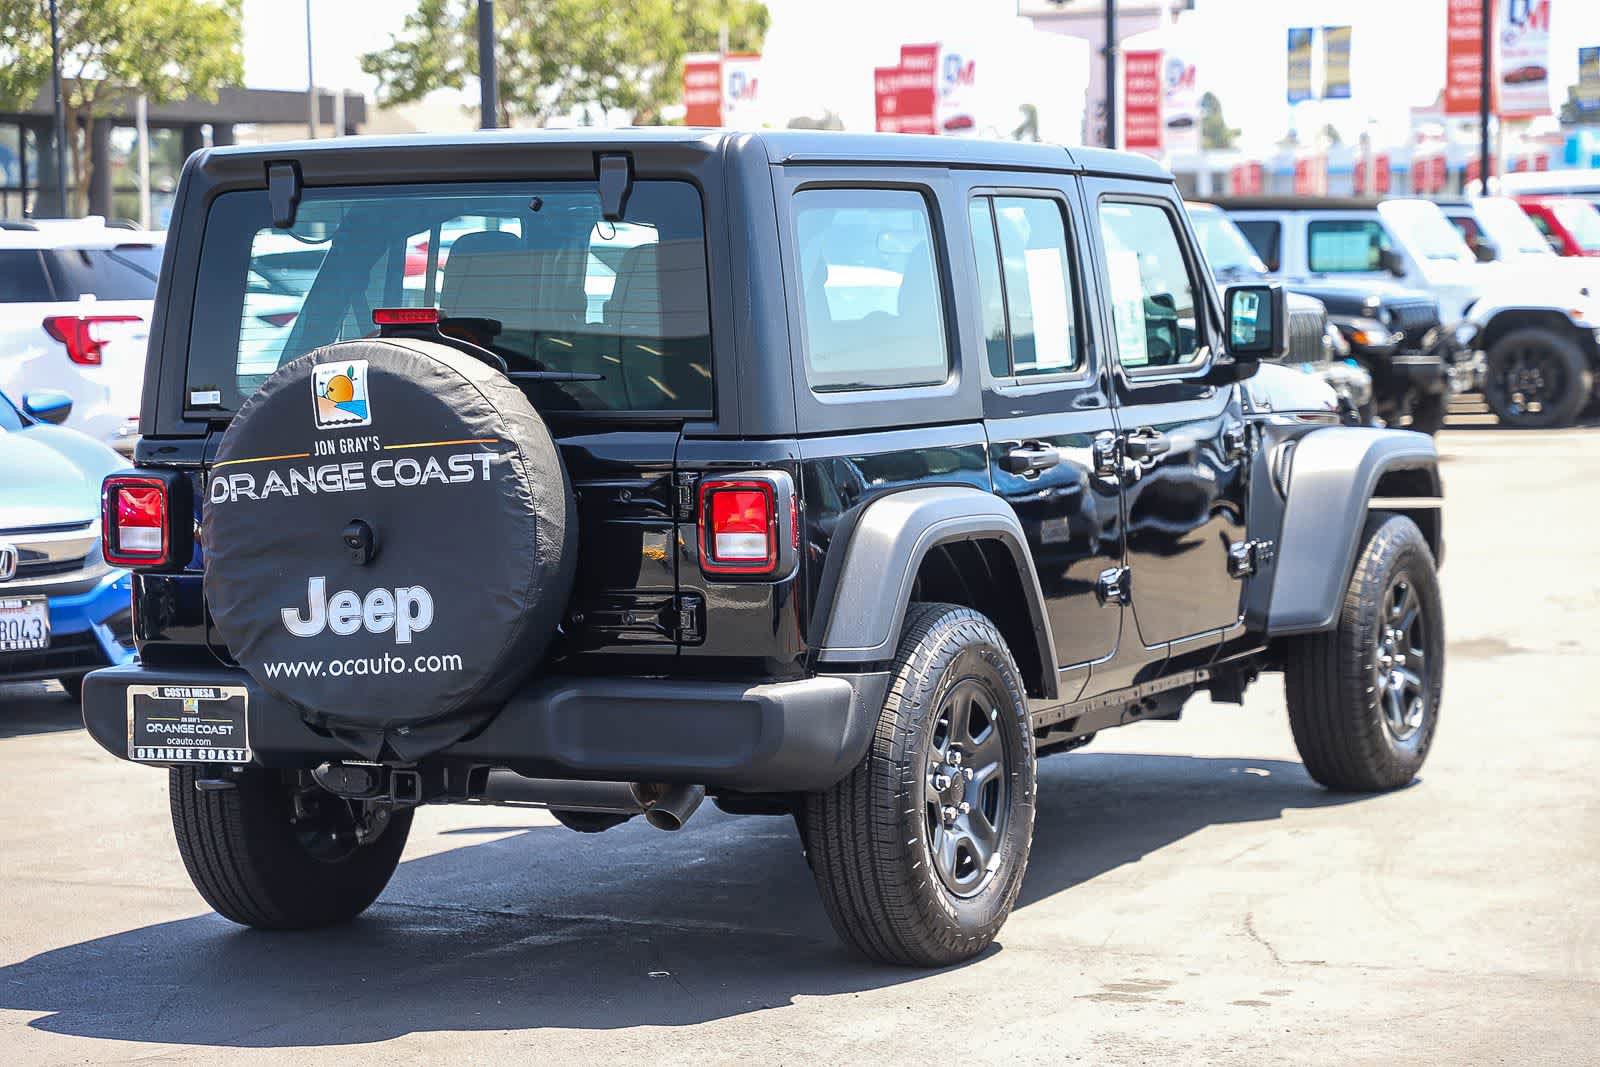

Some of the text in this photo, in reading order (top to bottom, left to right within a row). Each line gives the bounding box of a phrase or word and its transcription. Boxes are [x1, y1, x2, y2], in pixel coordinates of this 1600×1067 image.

[314, 436, 381, 457] JON GRAY'S
[210, 453, 500, 505] ORANGE COAST
[280, 576, 434, 645] Jeep
[264, 652, 463, 679] www.ocauto.com
[163, 687, 215, 698] COSTA MESA
[145, 723, 234, 736] ORANGE COAST
[166, 737, 212, 746] ocauto.com
[137, 748, 244, 760] ORANGE COAST
